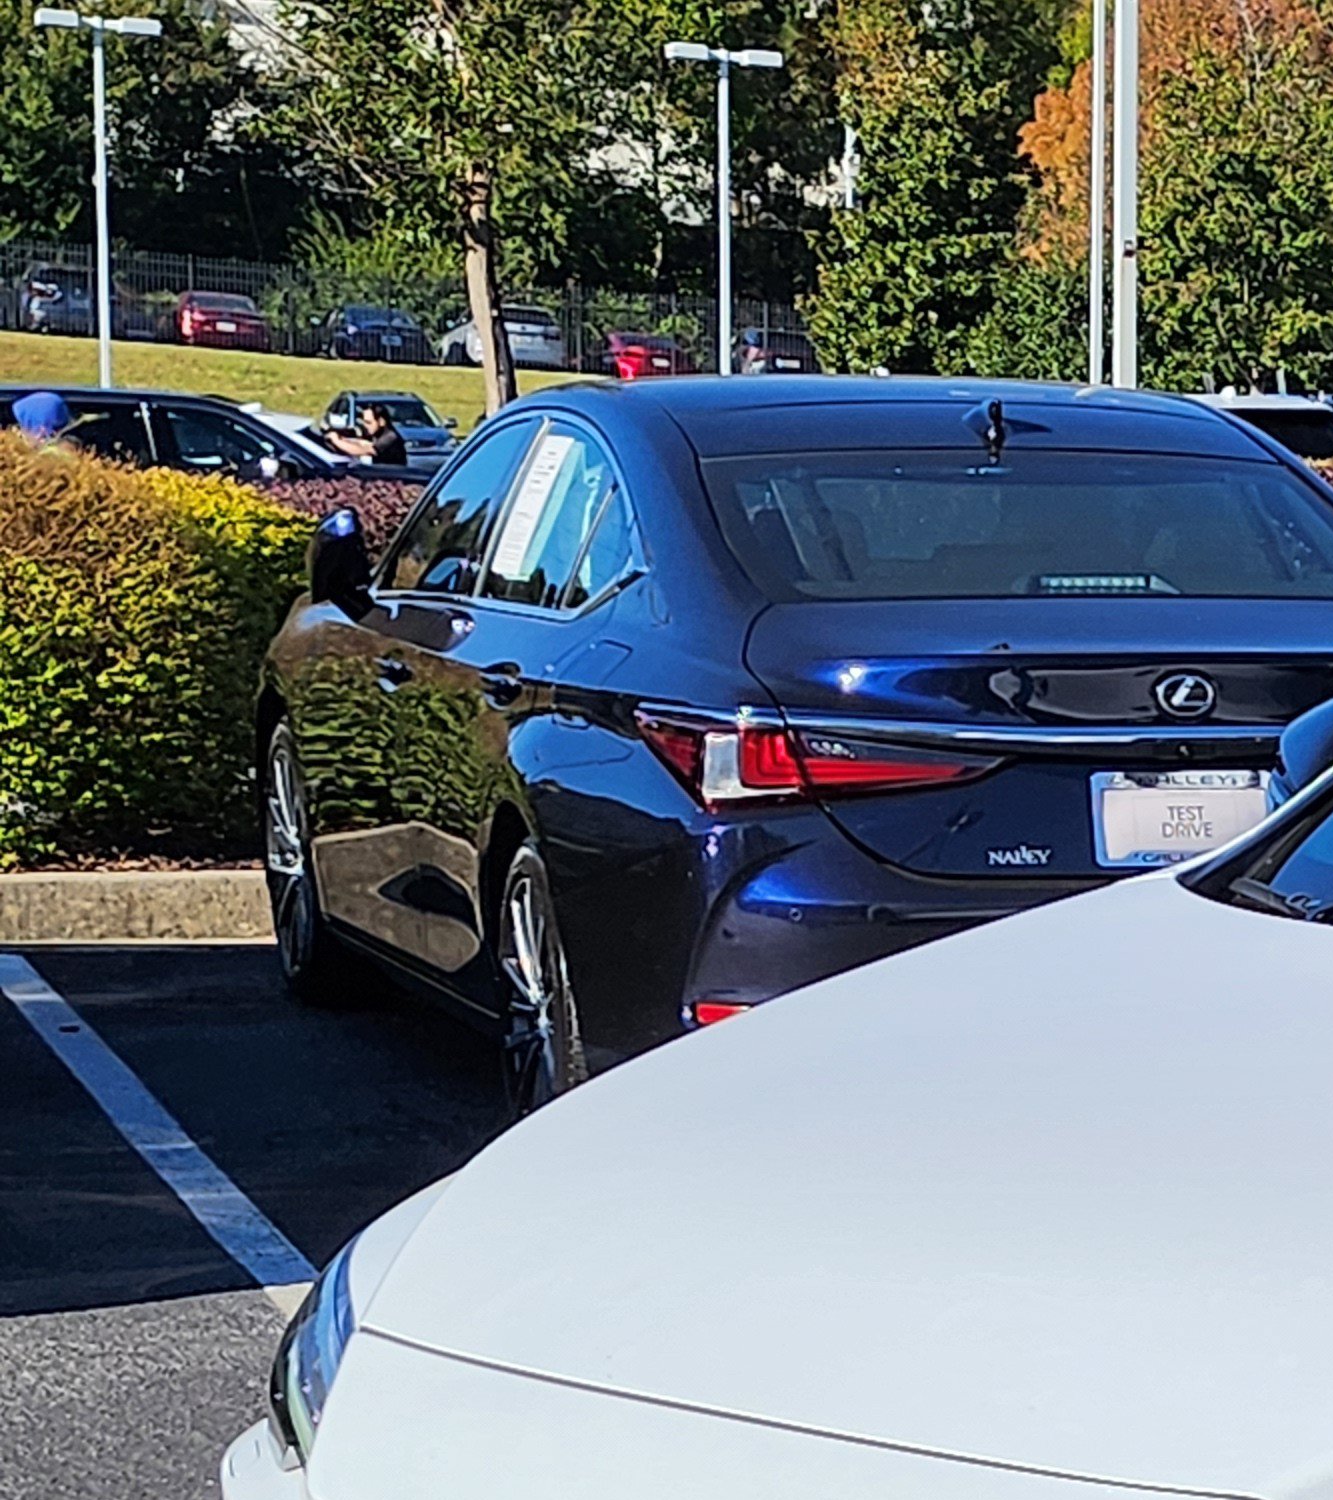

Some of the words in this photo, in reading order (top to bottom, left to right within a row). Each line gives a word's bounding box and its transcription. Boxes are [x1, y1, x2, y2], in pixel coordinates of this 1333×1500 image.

[1168, 805, 1205, 821] TEST
[1162, 821, 1213, 838] DRIVE
[987, 845, 1052, 866] NALLEY
